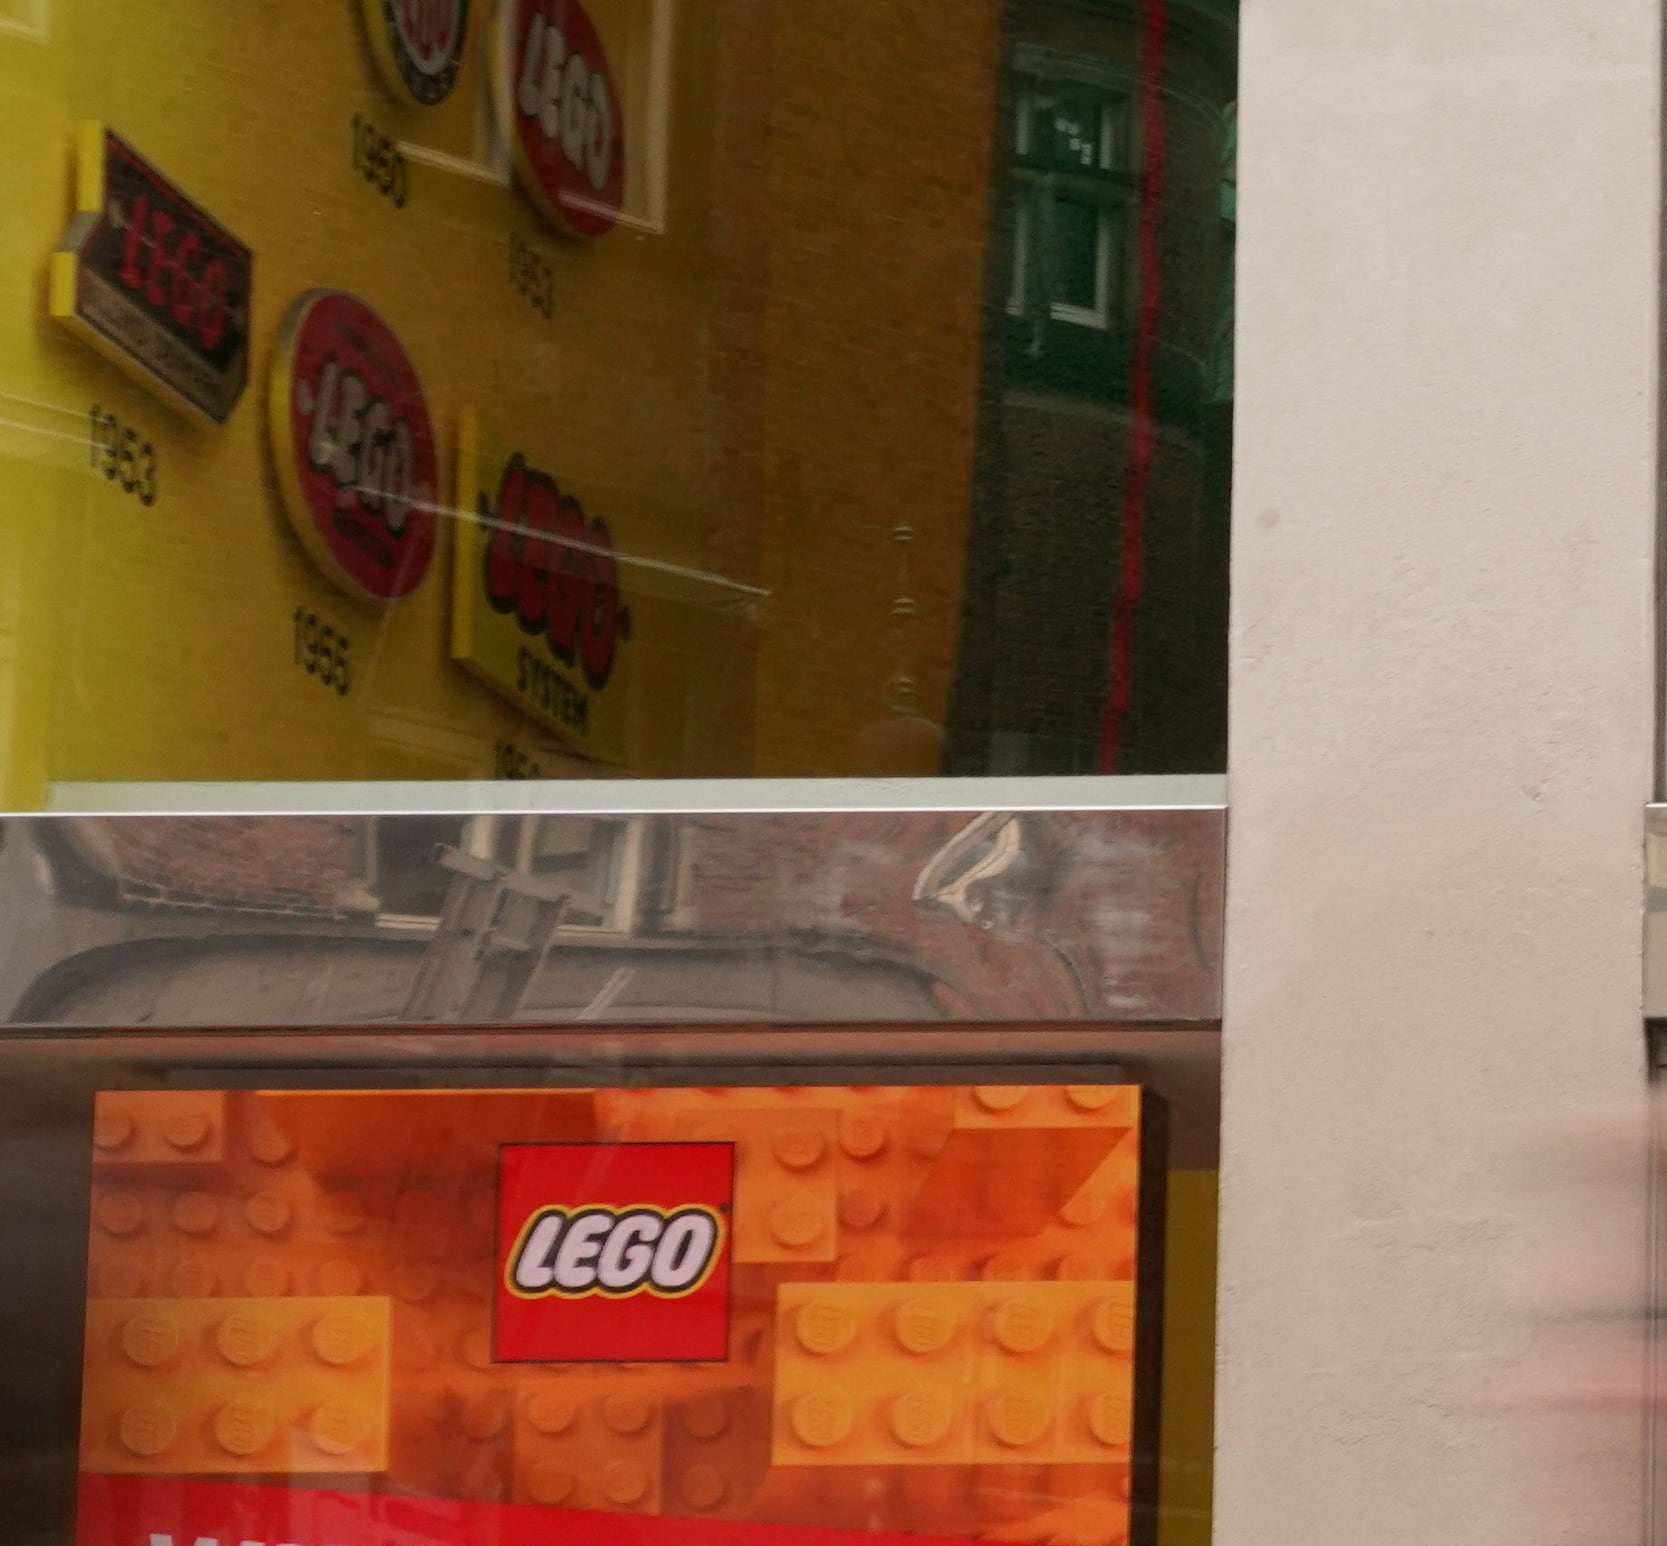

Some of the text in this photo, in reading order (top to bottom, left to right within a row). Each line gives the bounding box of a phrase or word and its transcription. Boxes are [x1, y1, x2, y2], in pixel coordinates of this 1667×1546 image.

[90, 404, 157, 508] 1953
[308, 354, 414, 534] LEGO
[293, 607, 351, 696] 1955
